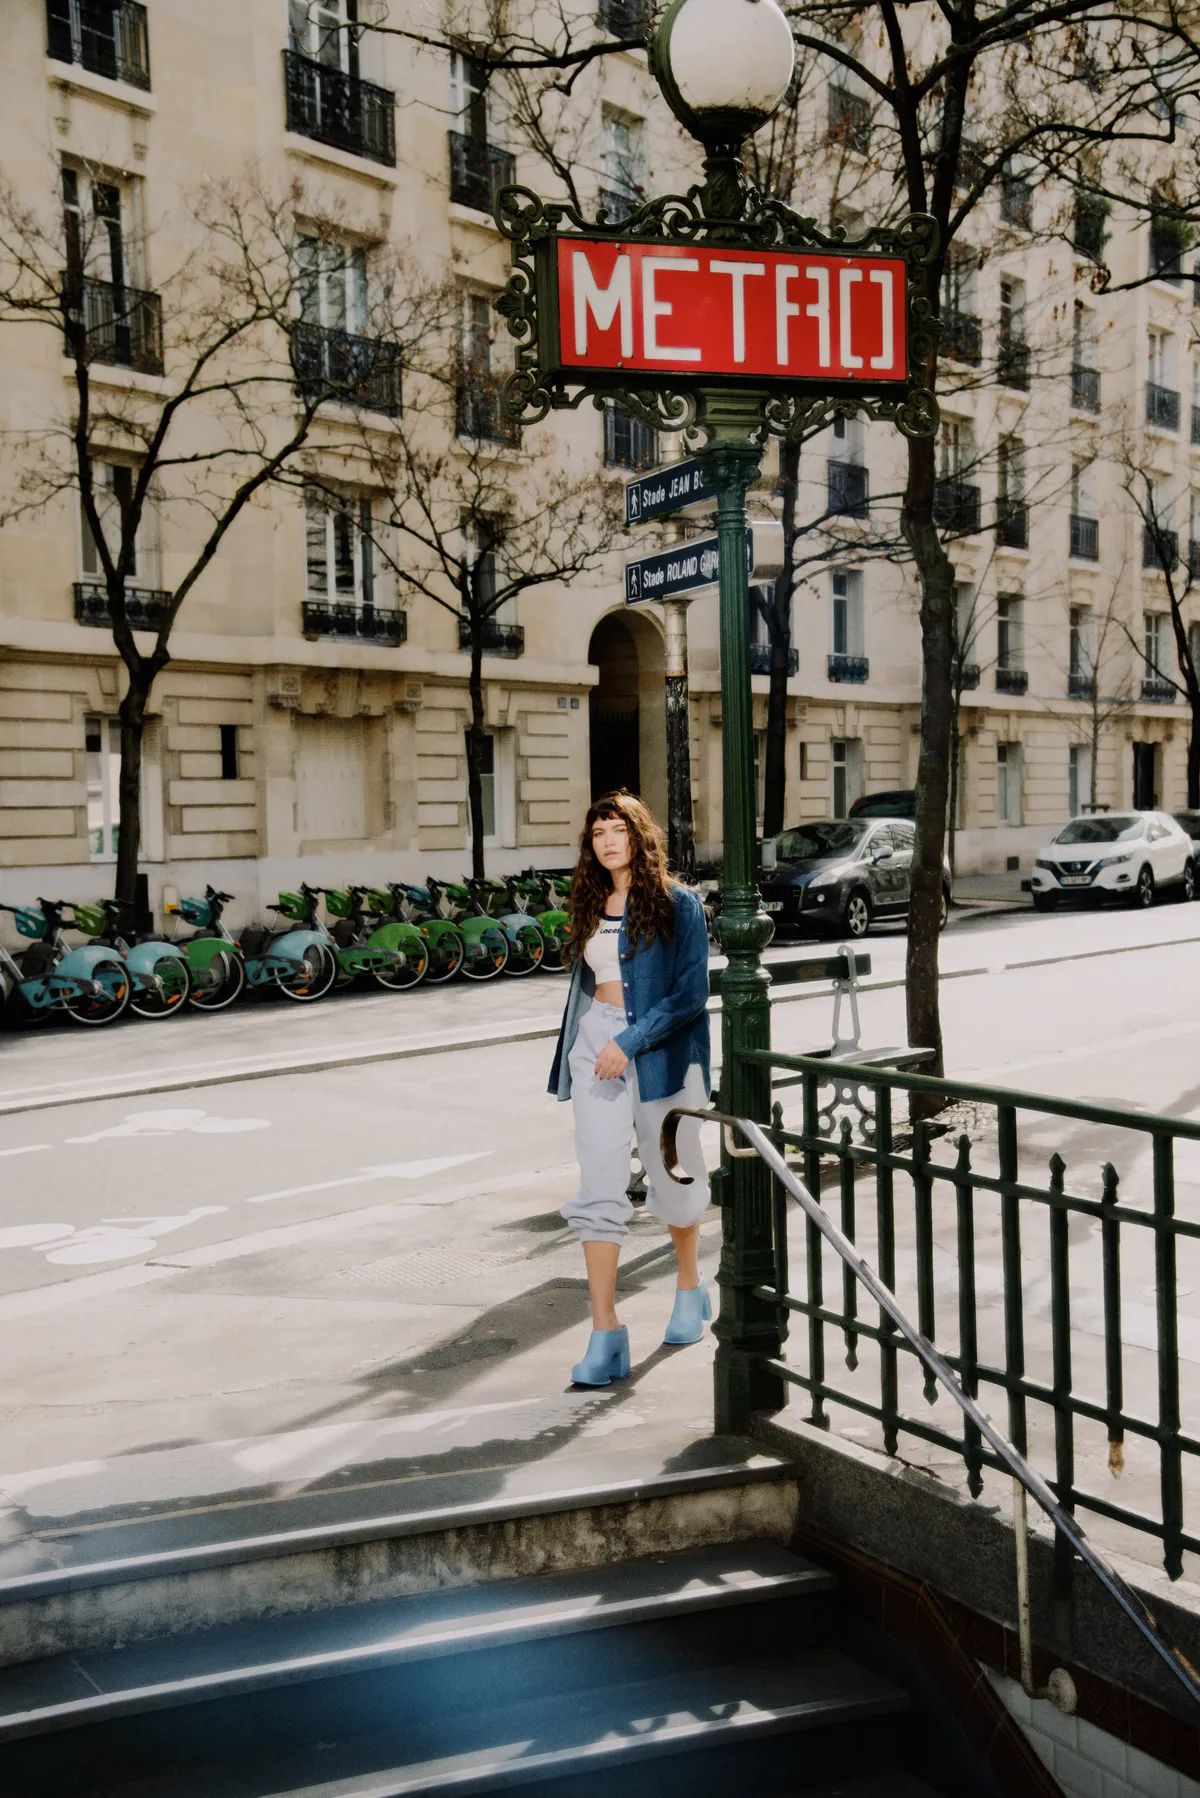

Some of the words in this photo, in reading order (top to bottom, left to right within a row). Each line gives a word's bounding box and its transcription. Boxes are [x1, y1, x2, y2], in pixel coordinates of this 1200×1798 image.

[572, 251, 893, 369] METRO
[642, 485, 666, 508] Stade
[668, 473, 689, 499] JEAN
[643, 567, 664, 588] Stade
[666, 555, 697, 582] ROLAND
